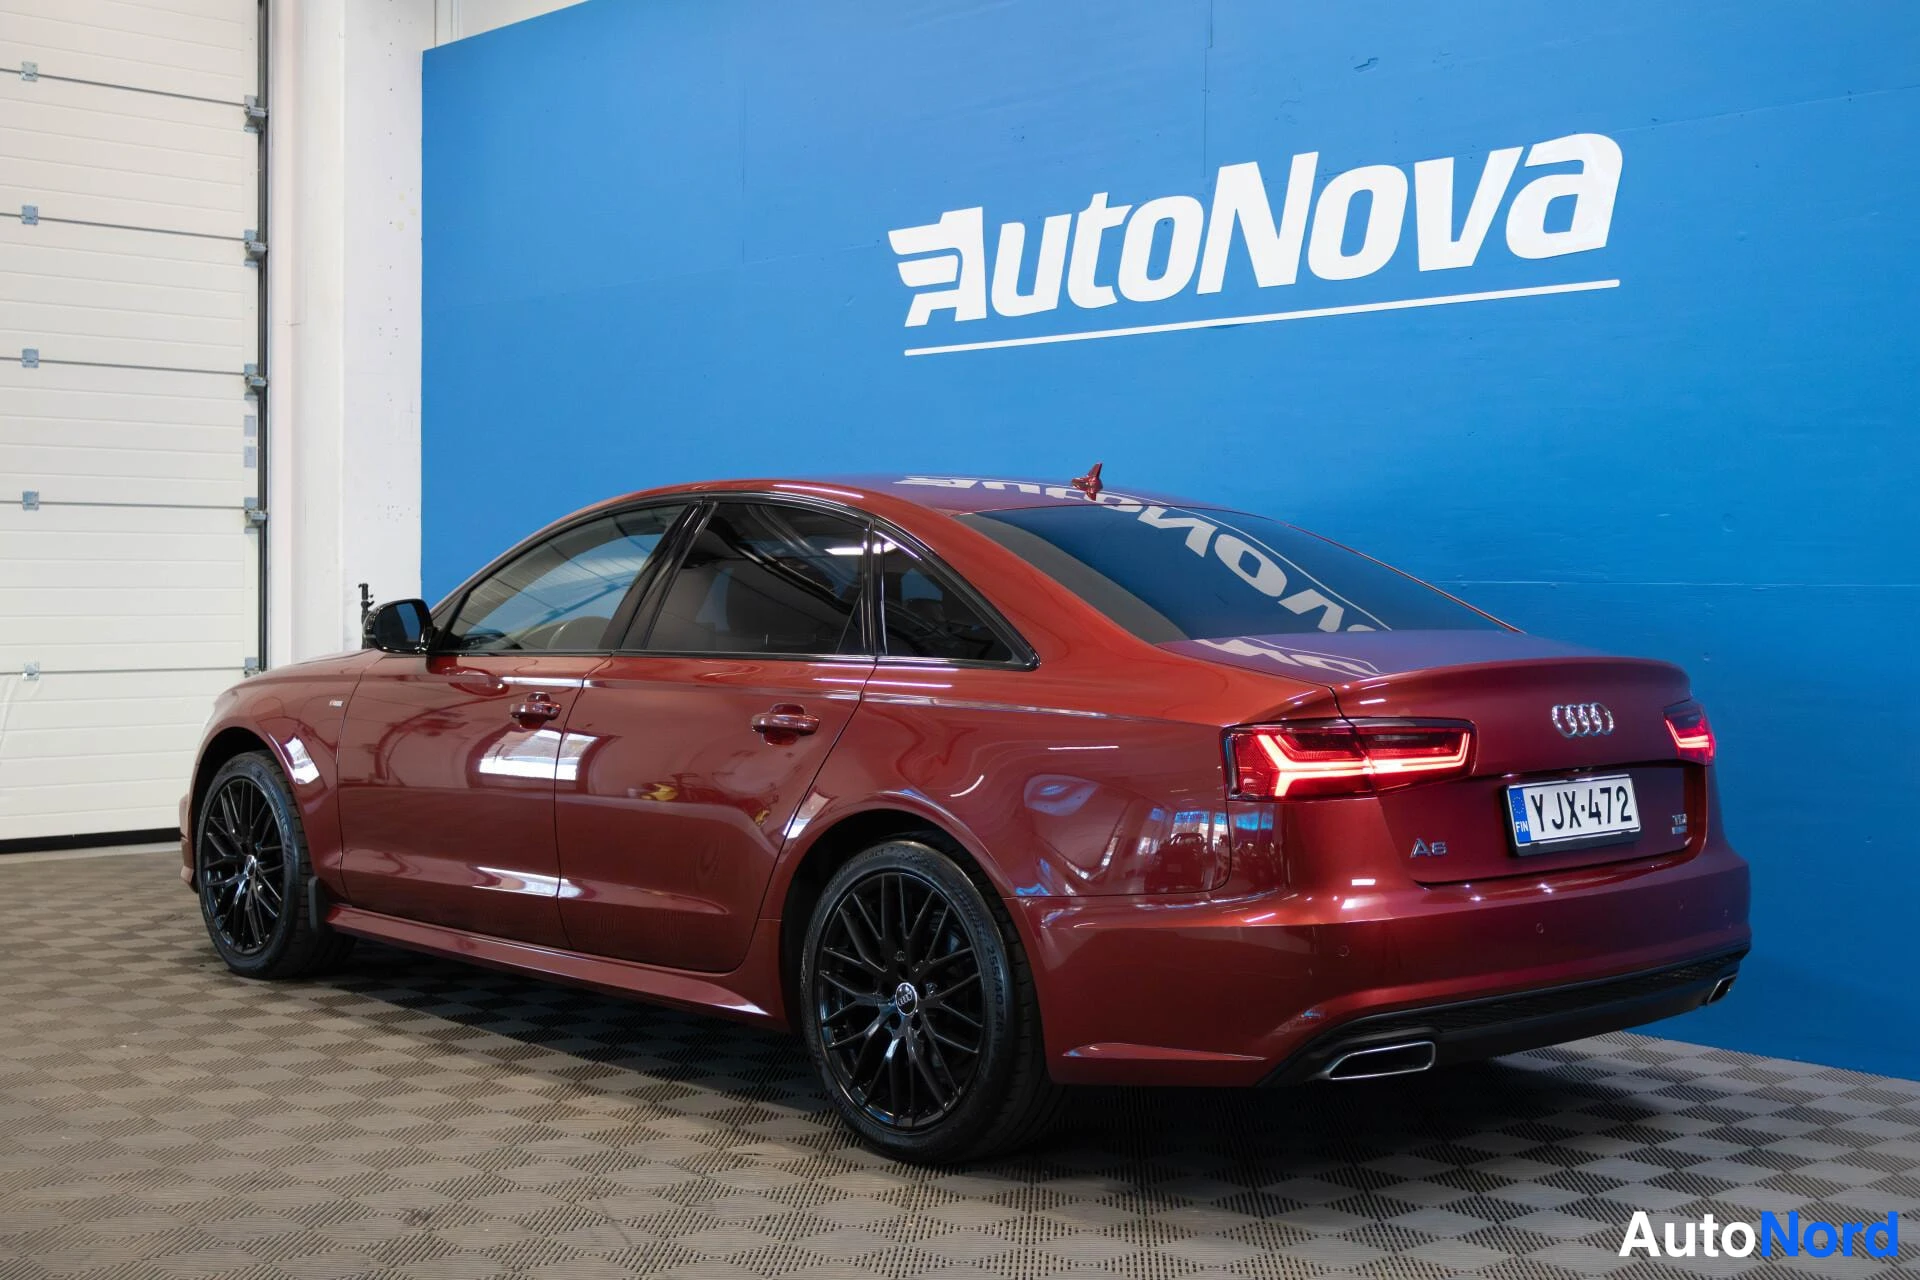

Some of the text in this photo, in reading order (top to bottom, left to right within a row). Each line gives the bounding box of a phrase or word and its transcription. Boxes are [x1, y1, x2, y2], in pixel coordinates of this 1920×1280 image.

[888, 133, 1623, 327] AutoNova
[1515, 820, 1529, 833] FIN
[1531, 785, 1632, 832] YJX-472
